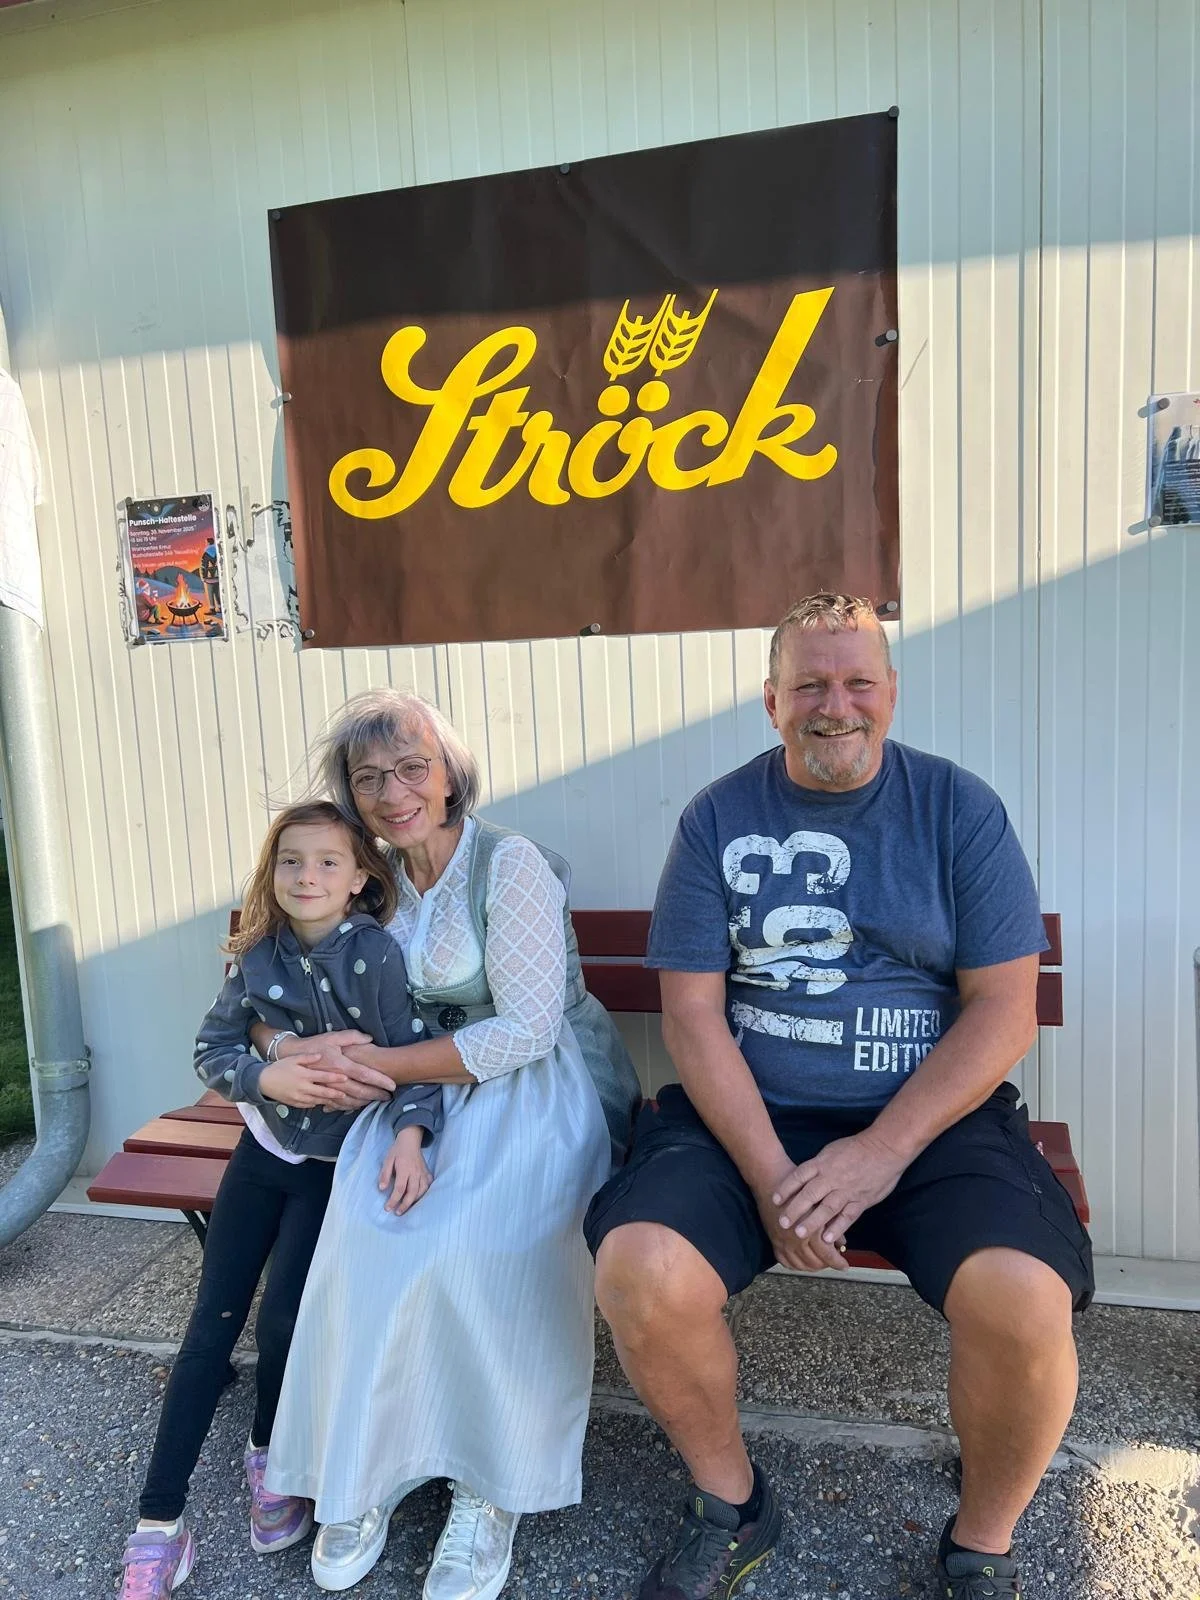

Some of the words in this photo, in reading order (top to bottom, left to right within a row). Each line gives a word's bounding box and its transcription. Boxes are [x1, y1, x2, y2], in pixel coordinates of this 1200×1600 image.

[328, 287, 838, 520] Ströck
[129, 514, 197, 527] Punsch-Haltestelle
[722, 830, 854, 1049] 1963
[855, 1006, 941, 1038] LIMITED
[853, 1040, 936, 1074] EDITI
